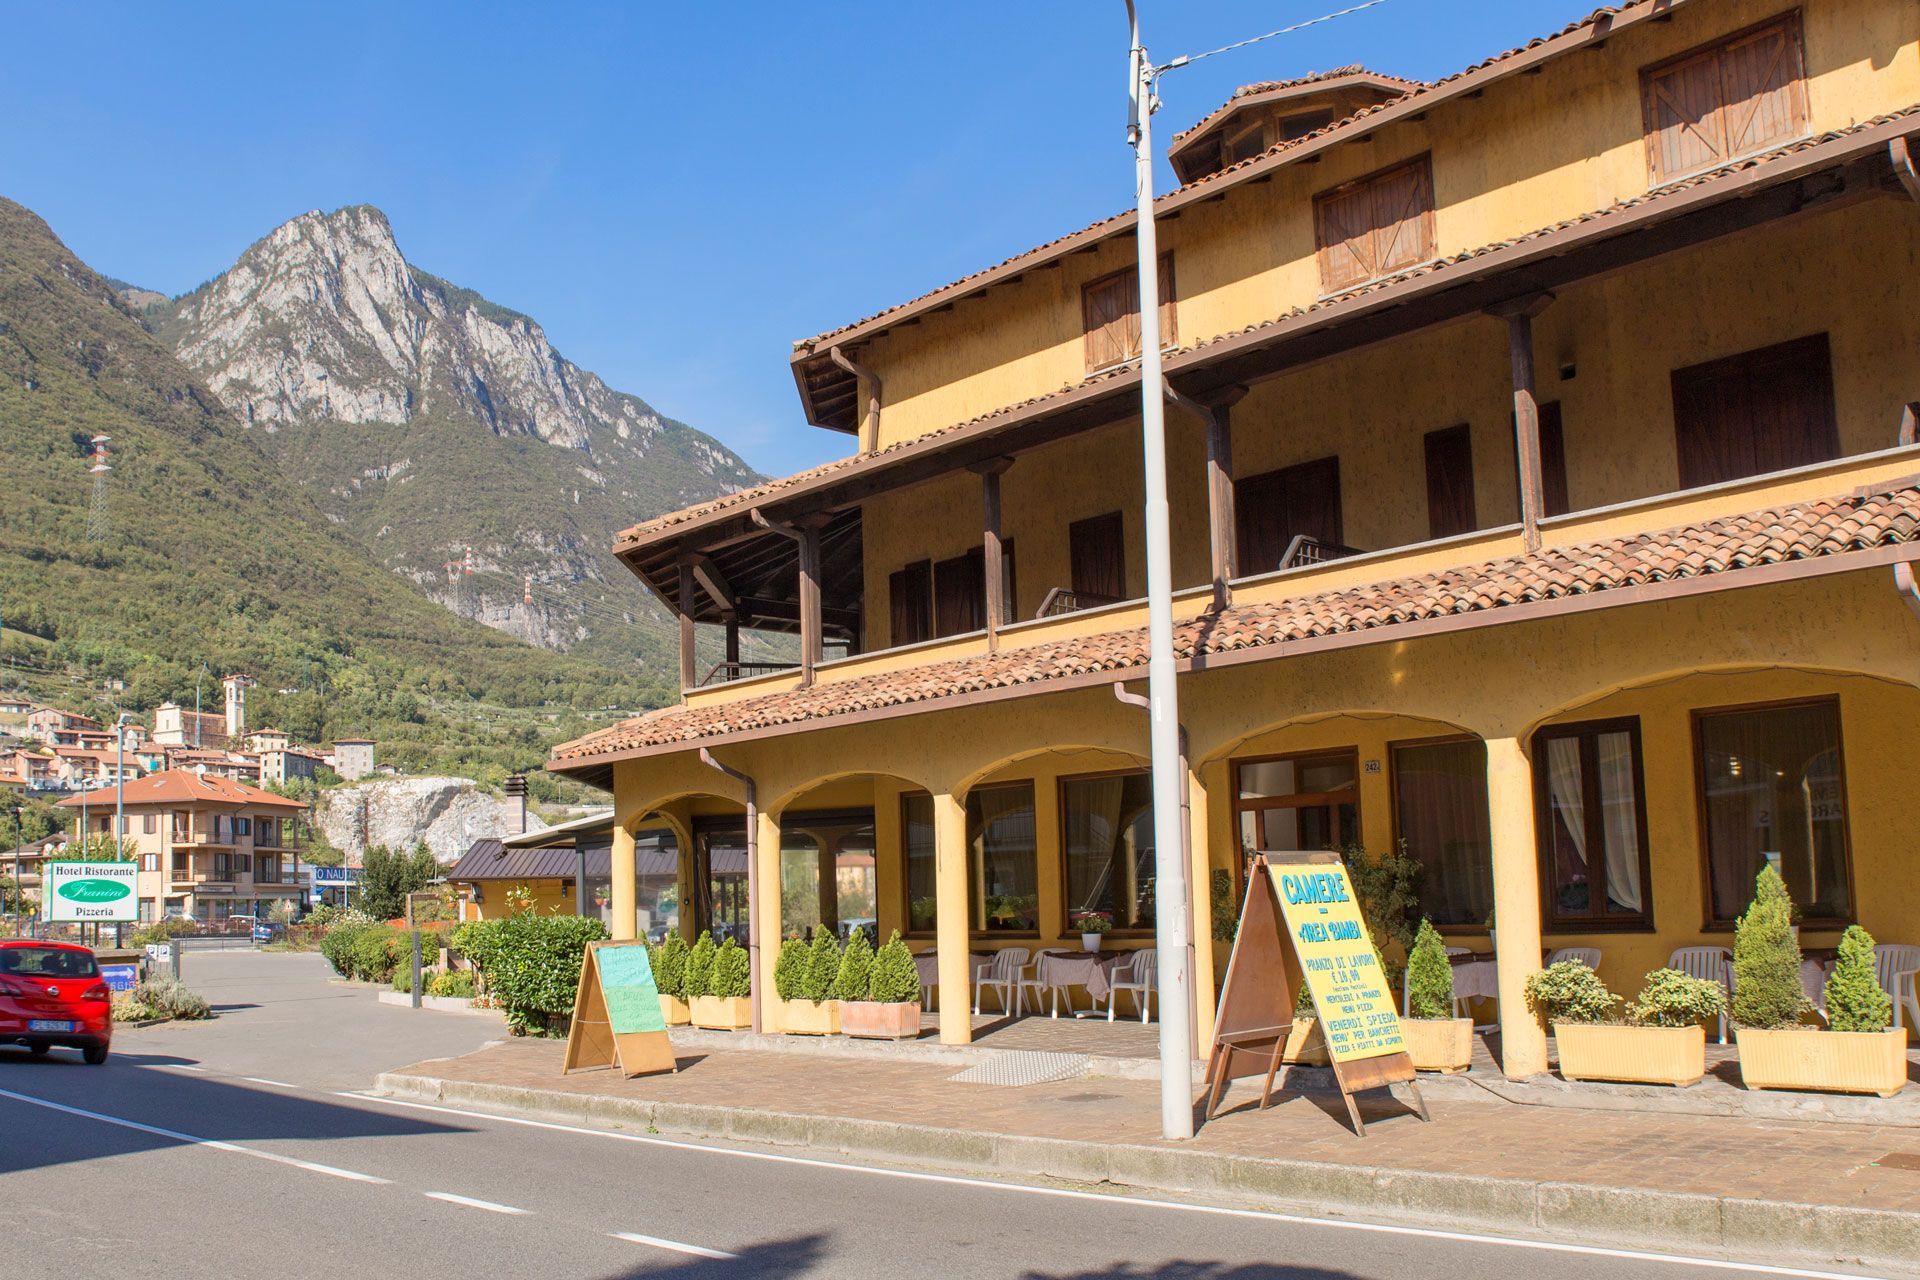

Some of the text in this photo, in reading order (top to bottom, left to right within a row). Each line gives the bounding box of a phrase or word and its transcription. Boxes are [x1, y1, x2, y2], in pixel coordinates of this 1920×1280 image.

[56, 867, 134, 876] Hotel Ristorante
[64, 882, 125, 898] Franini
[1282, 873, 1349, 905] CAMERE
[76, 908, 113, 916] Pizzeria
[1299, 920, 1362, 943] AREA BIMBI
[1306, 954, 1375, 971] PRANZO DI LAVORO
[1357, 1003, 1373, 1012] PIZZA
[1367, 1013, 1396, 1026] SPIEDO
[1354, 1031, 1365, 1040] PER
[1368, 1025, 1400, 1038] BANCHETTI
[1335, 1045, 1350, 1053] PIZZA
[1357, 1041, 1375, 1050] PIATTI
